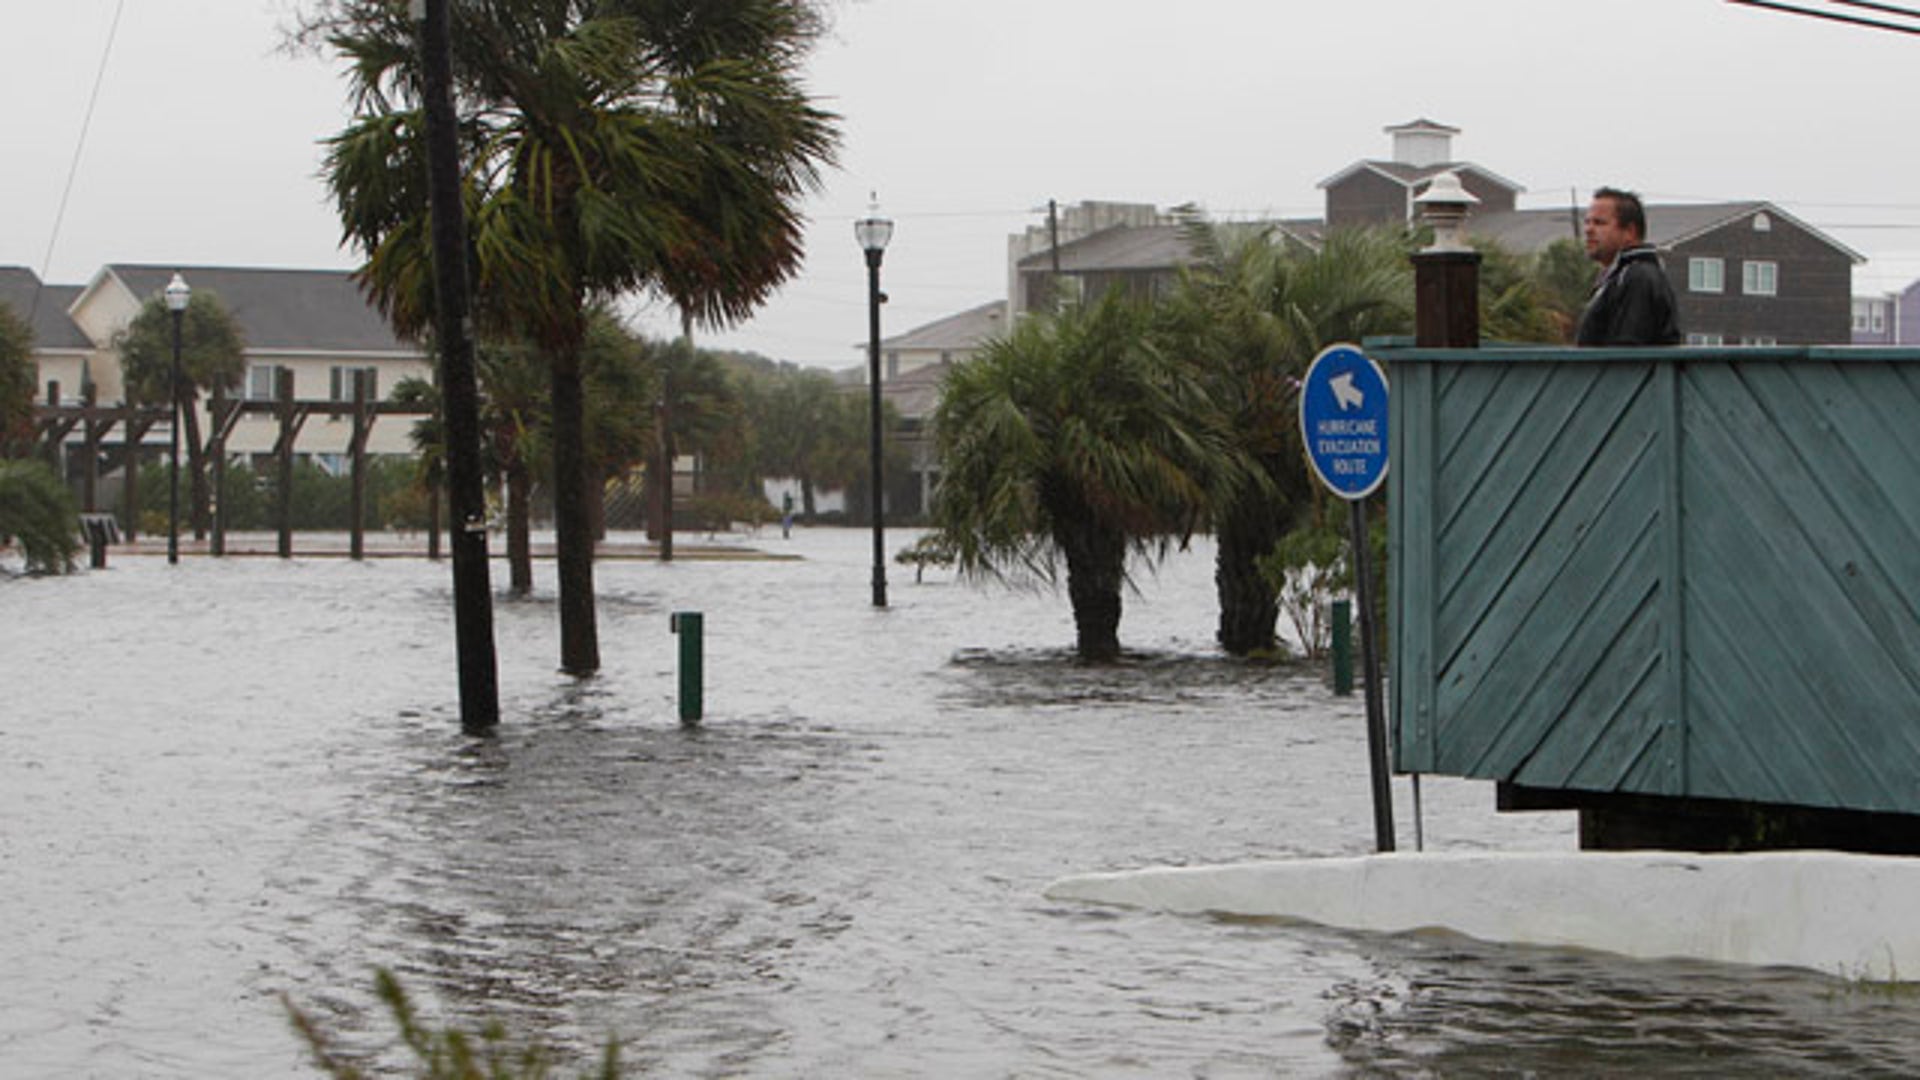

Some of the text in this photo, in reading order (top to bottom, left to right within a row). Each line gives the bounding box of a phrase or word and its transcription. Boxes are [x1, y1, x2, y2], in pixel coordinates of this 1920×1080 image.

[1318, 420, 1377, 435] HURRICANE
[1318, 439, 1380, 454] EVACUATION
[1333, 459, 1367, 475] ROUTE
